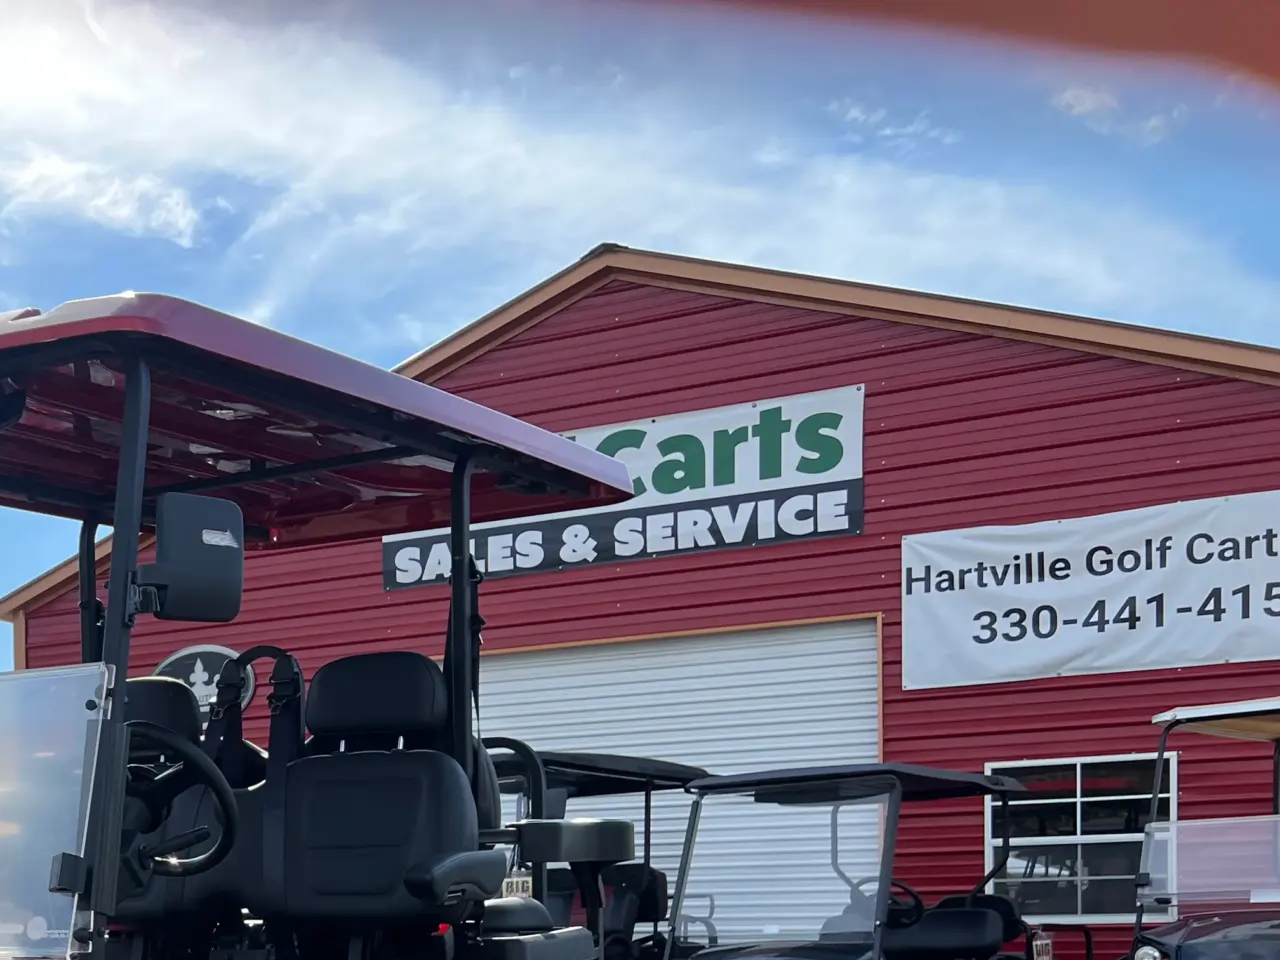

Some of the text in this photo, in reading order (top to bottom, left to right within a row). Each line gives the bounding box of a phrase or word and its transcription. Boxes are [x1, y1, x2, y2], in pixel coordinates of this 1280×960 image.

[559, 524, 599, 564] &
[613, 490, 850, 558] SERVICE
[905, 551, 1072, 596] Hartville
[1085, 535, 1173, 577] Golf
